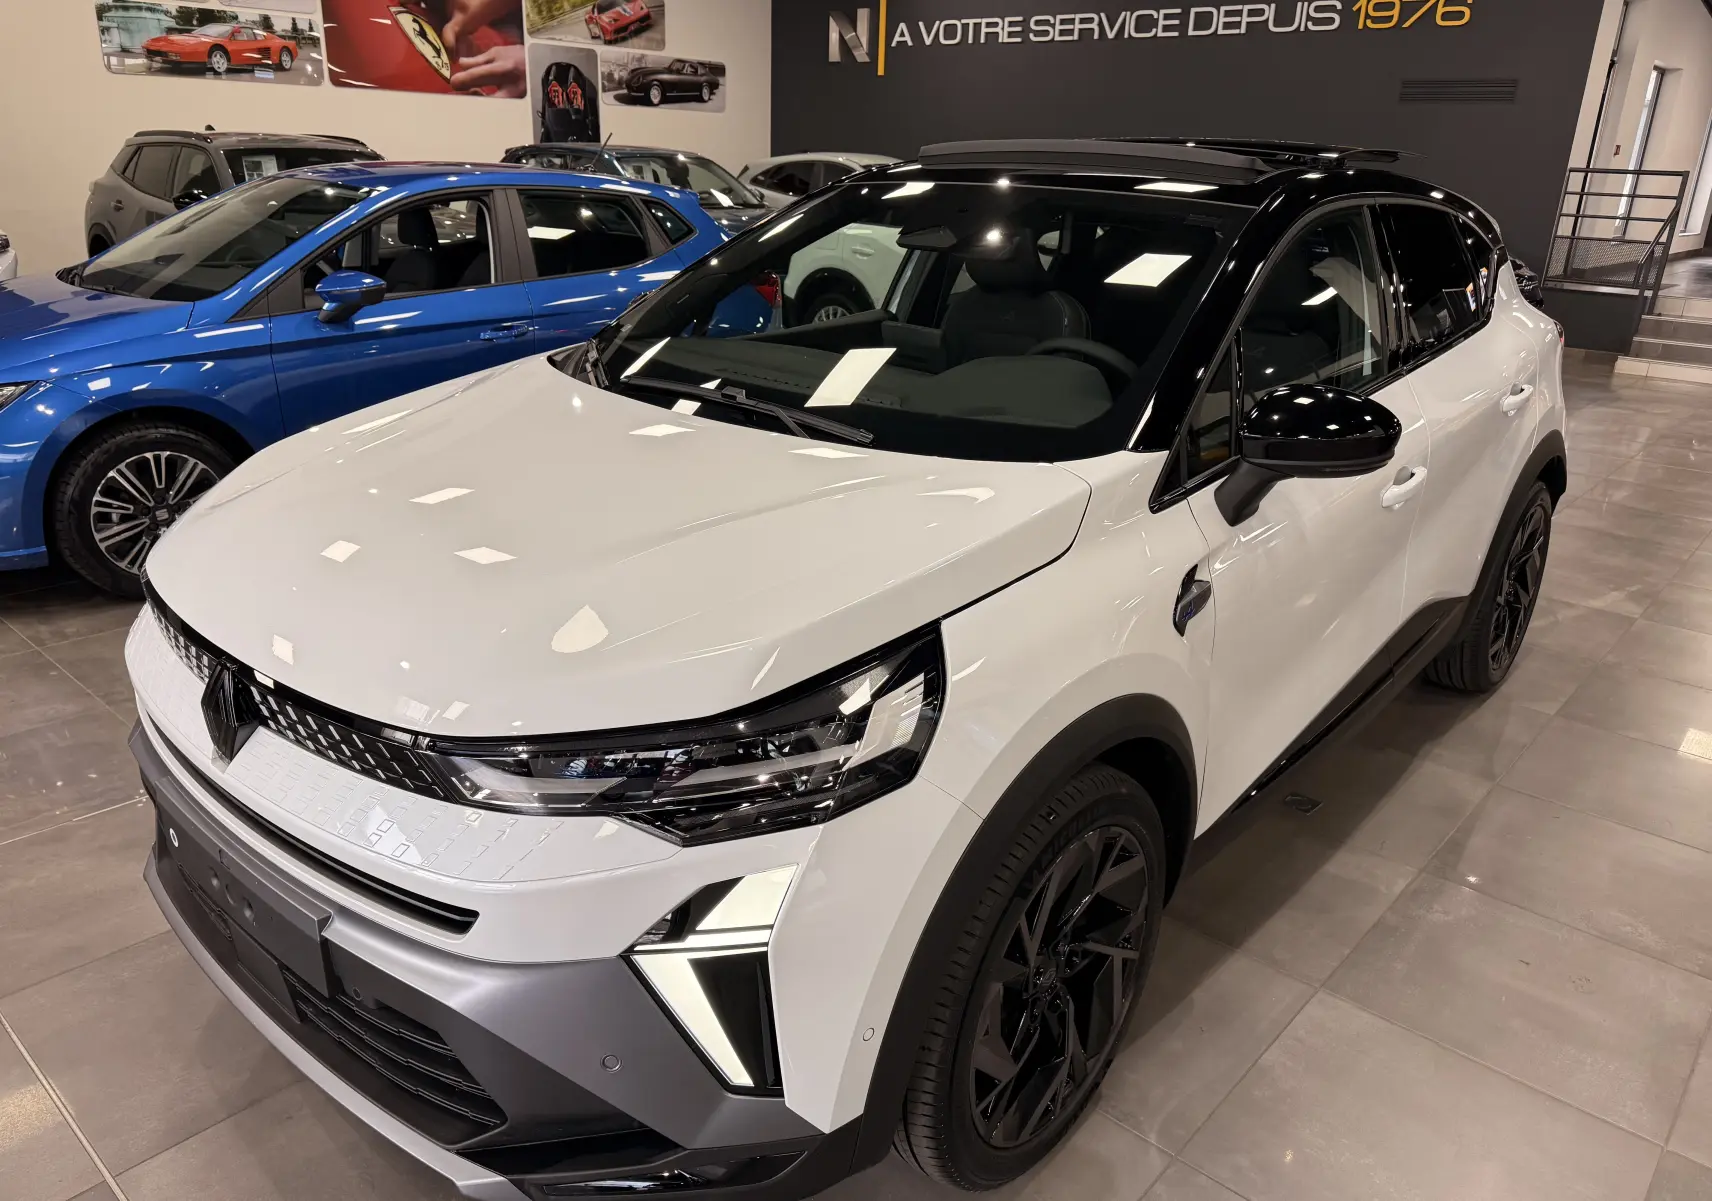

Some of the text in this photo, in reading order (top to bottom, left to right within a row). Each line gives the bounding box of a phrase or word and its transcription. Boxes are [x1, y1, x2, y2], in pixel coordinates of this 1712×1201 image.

[890, 0, 1473, 48] A VOTRE SERVICE DEPUIS 1976
